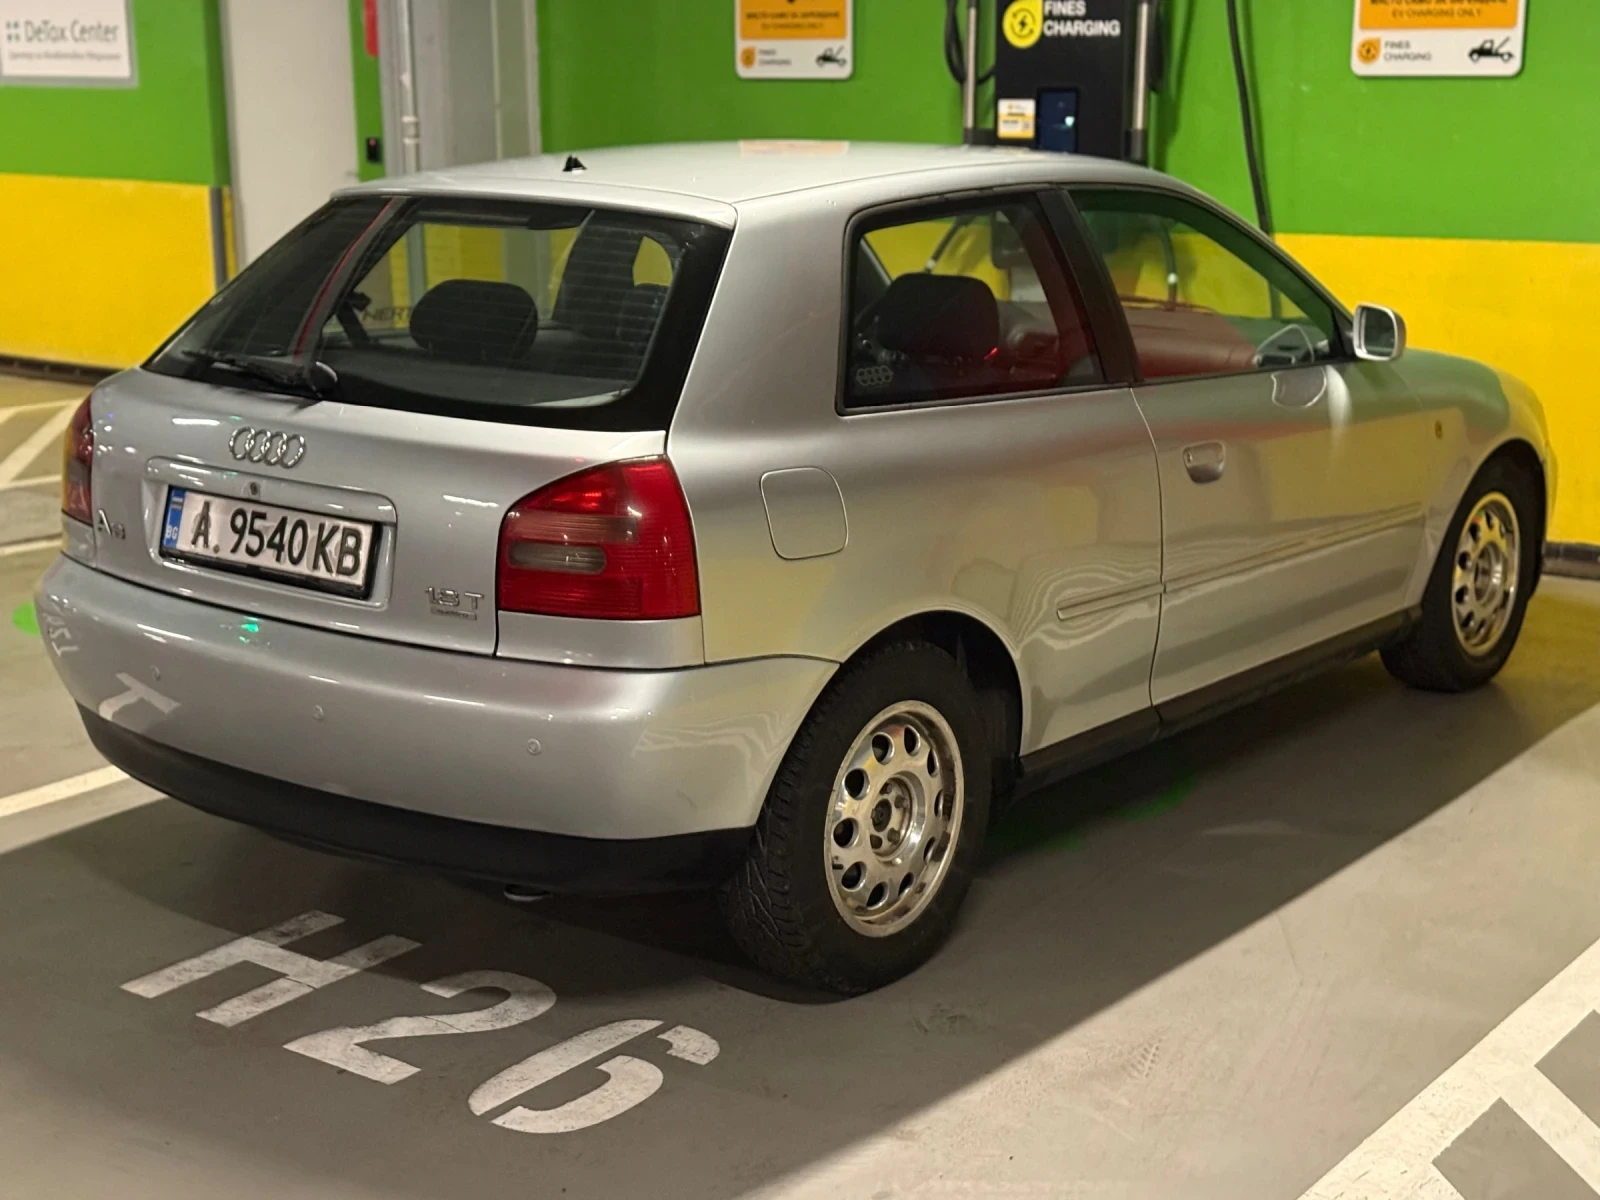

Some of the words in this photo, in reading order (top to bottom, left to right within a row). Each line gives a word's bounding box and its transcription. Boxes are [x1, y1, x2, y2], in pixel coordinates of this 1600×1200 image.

[1044, 0, 1086, 16] FINES
[70, 19, 119, 43] Center
[1043, 19, 1121, 37] CHARGING
[119, 909, 720, 1134] H26
